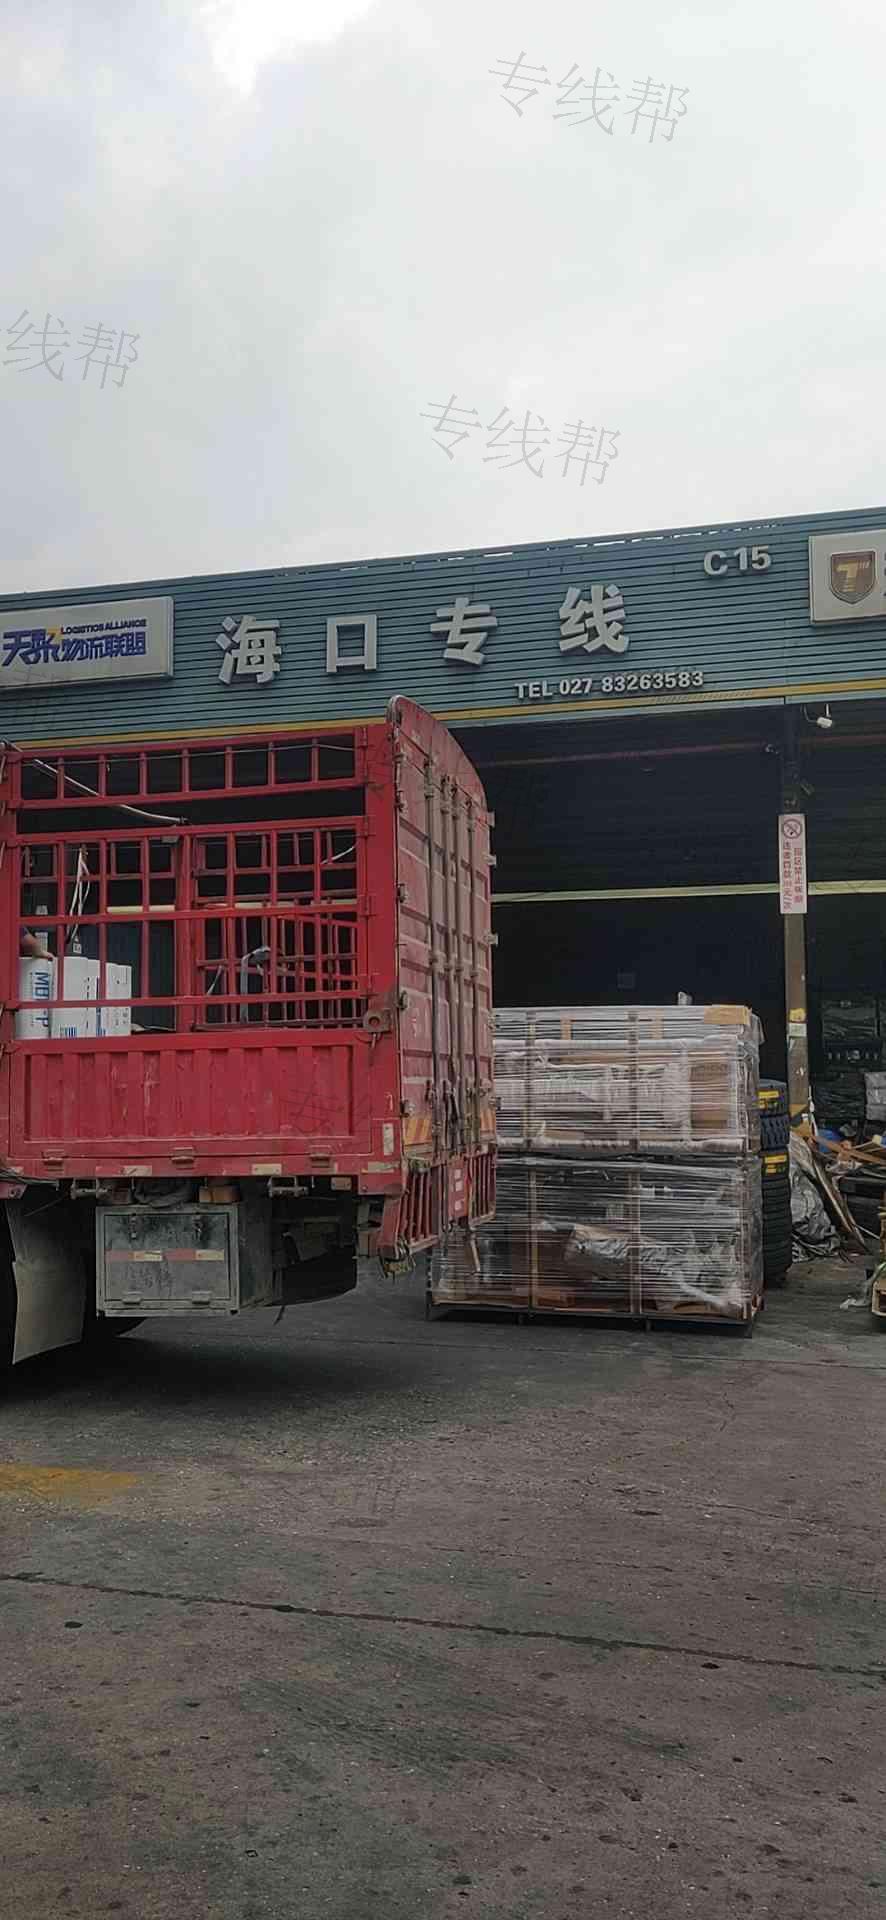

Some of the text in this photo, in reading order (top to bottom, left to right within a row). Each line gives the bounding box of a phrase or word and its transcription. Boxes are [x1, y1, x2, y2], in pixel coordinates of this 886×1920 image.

[61, 618, 147, 635] LOGISTICS ALLIANCE
[515, 670, 705, 700] TEL 027 83263583
